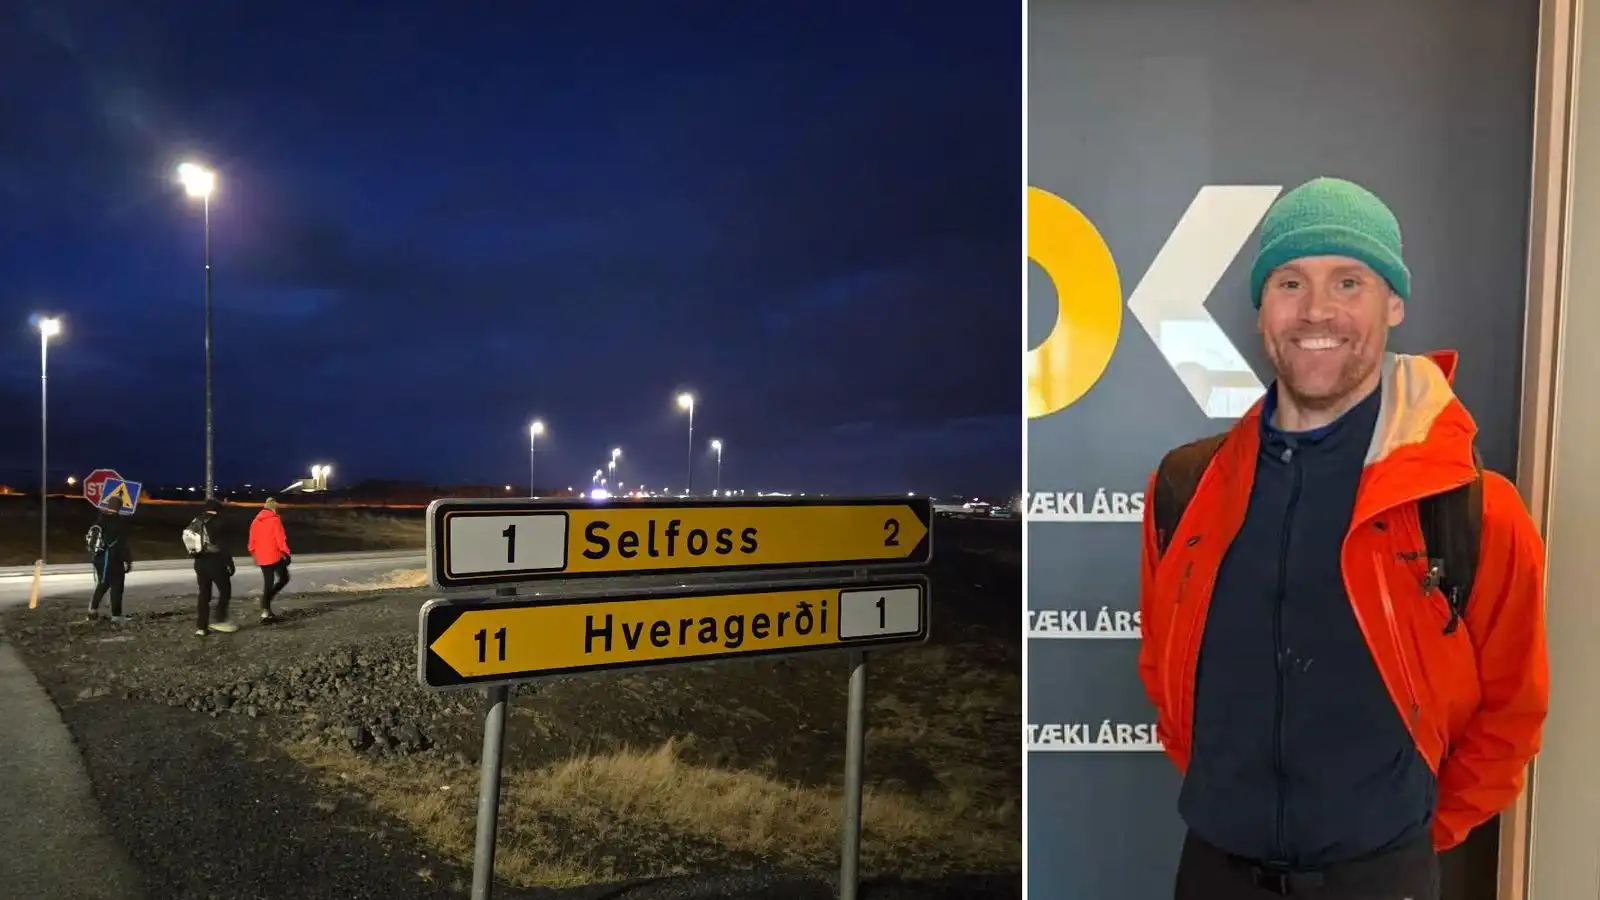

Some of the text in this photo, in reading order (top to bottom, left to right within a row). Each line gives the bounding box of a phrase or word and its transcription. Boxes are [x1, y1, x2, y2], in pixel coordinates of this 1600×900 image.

[87, 482, 104, 497] ST
[1028, 492, 1084, 514] ÆKI
[502, 518, 900, 564] 1 Selfoss 2
[474, 597, 887, 662] 11 Hveragerði 1
